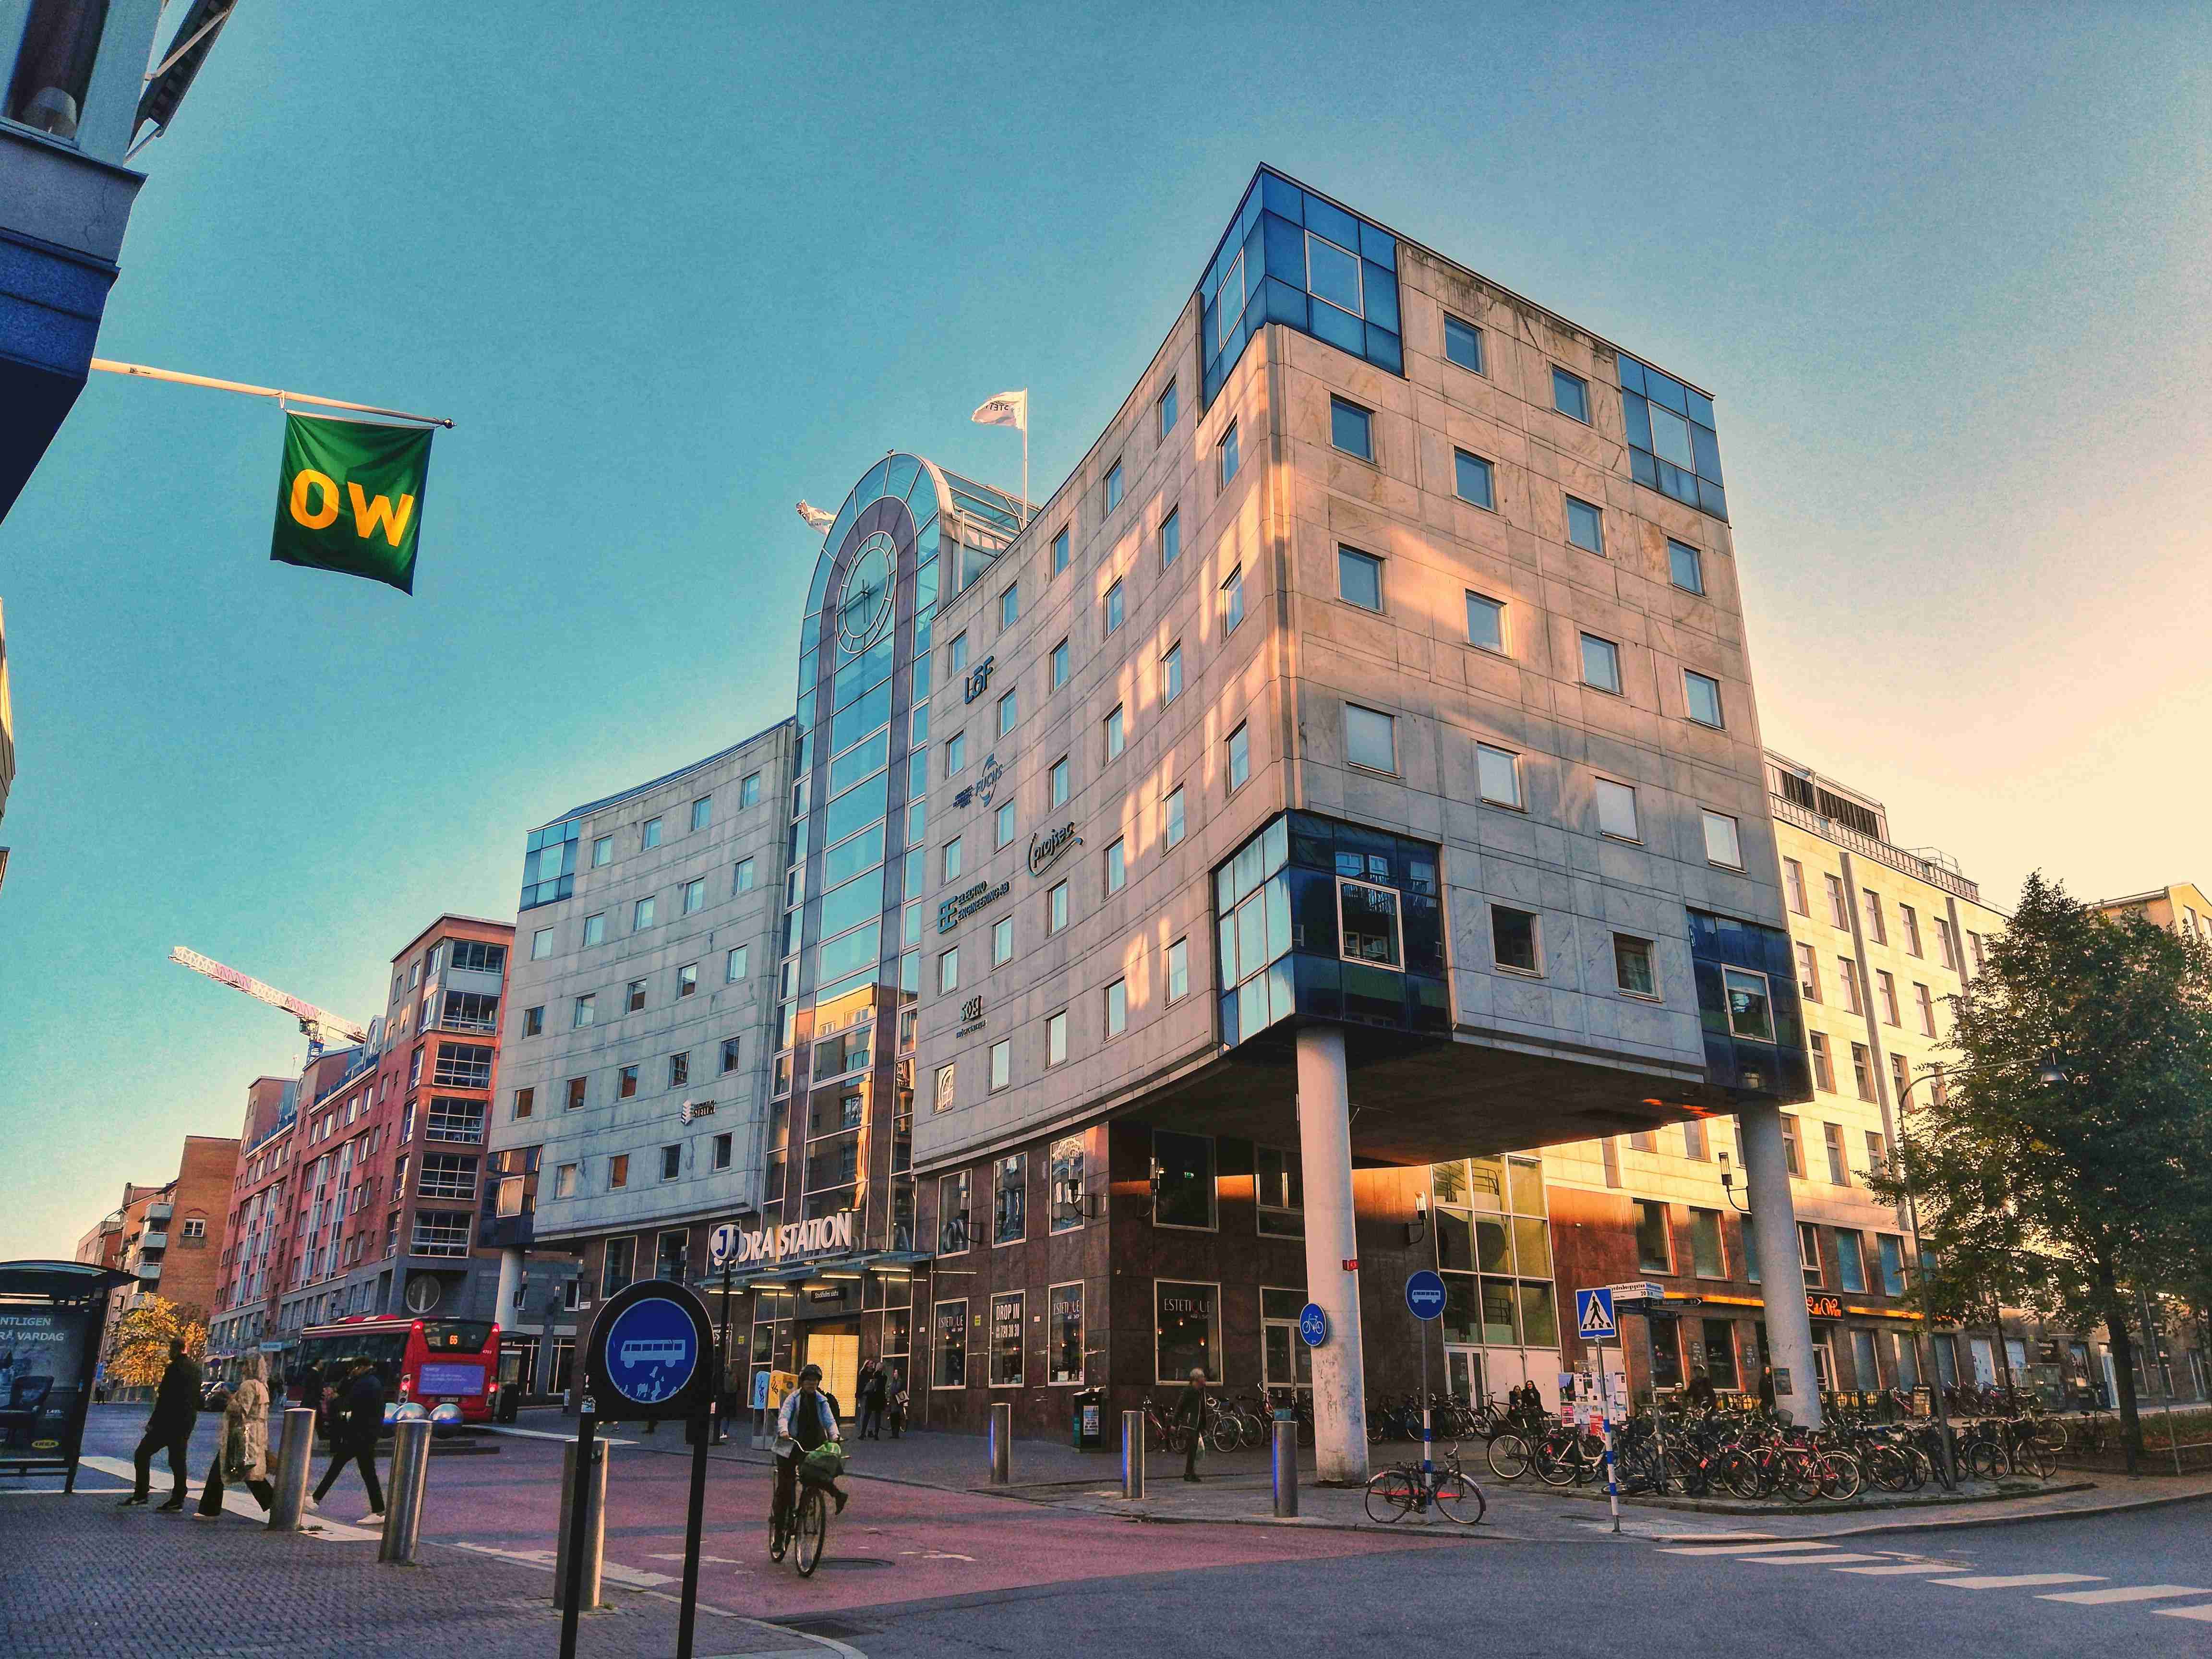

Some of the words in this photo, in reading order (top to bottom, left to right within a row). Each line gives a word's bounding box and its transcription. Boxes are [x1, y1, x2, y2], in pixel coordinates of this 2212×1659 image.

[290, 469, 414, 547] OW
[975, 763, 1003, 797] FUCHS
[780, 1213, 852, 1256] STATION
[815, 1290, 830, 1298] Stockholms
[996, 1304, 1011, 1321] DROP
[1013, 1302, 1020, 1319] IN
[0, 1317, 51, 1326] NTLIGEN
[938, 1314, 963, 1328] ESTETIUE
[0, 1329, 13, 1340] RÅ
[17, 1332, 64, 1341] VARDAG
